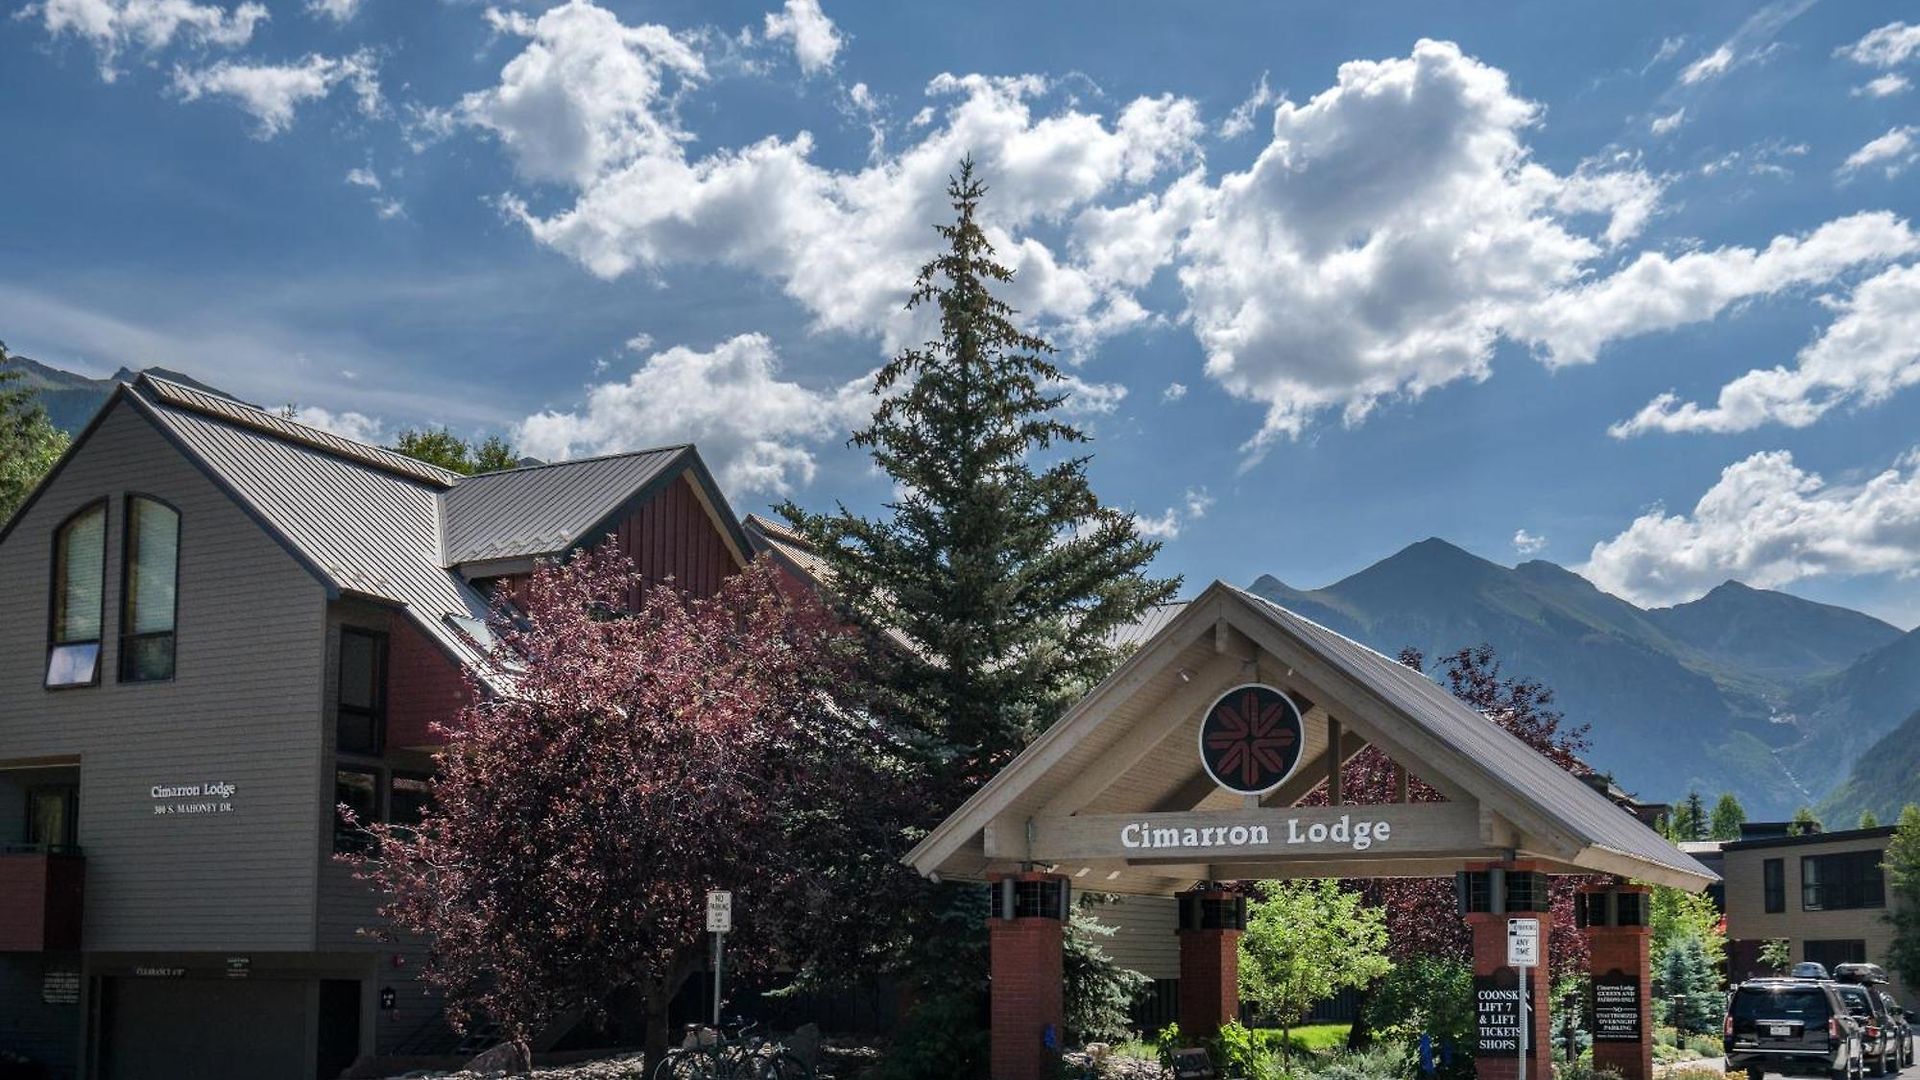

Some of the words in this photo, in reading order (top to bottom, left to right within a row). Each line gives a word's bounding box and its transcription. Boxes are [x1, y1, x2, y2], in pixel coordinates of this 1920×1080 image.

[152, 785, 200, 798] Cimarron
[204, 782, 235, 798] Lodge
[177, 803, 216, 813] MAHONEY
[220, 802, 234, 812] DR.
[1120, 822, 1269, 849] Cimarron
[1286, 814, 1391, 851] Lodge
[1515, 947, 1530, 955] TIME
[1478, 990, 1530, 1000] COONSKN
[1478, 1002, 1503, 1012] LIFT
[1505, 1002, 1512, 1012] 7
[1479, 1014, 1487, 1024] &
[1490, 1014, 1516, 1024] LIFT
[1479, 1026, 1521, 1037] TICKETS
[1479, 1039, 1516, 1049] SHOPS
